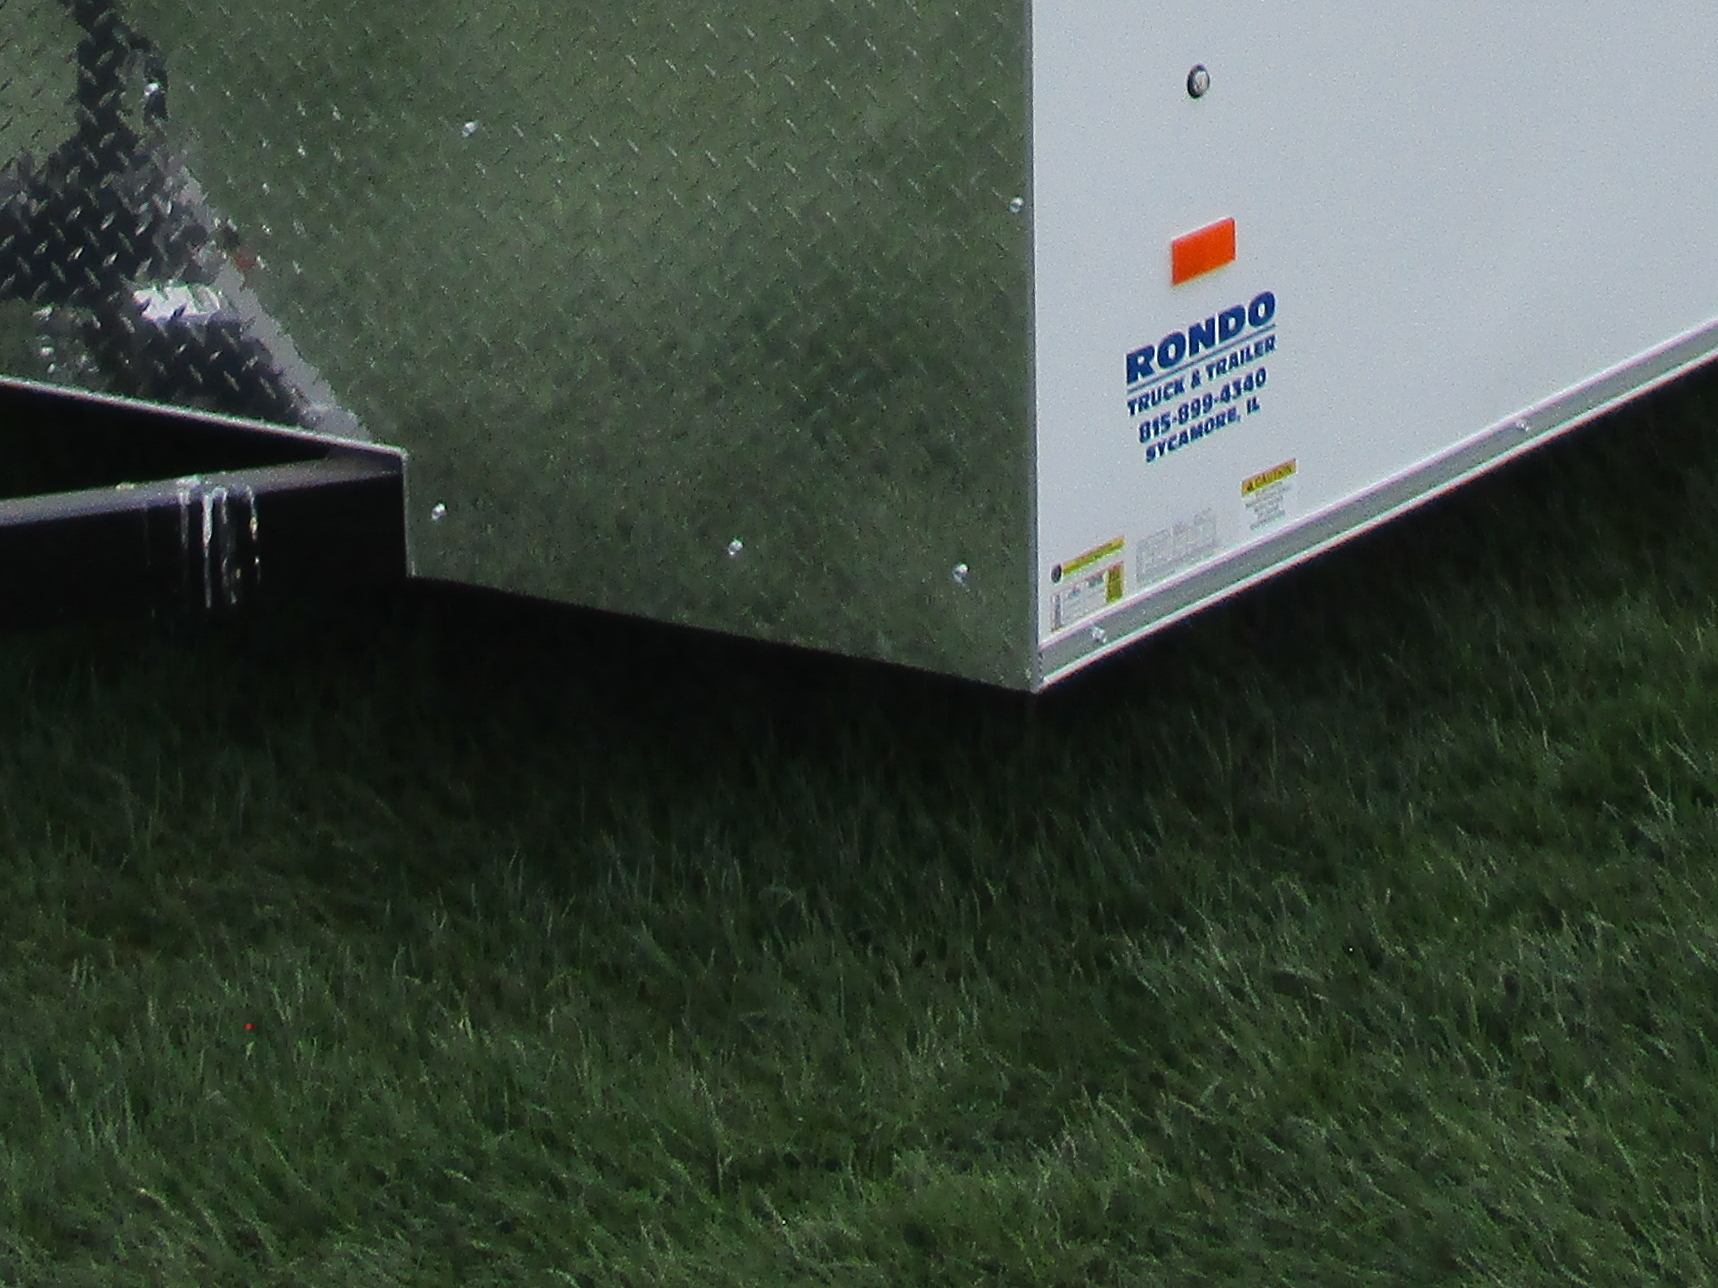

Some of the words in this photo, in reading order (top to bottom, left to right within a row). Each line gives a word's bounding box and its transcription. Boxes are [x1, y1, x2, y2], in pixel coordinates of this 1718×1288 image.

[1126, 291, 1276, 385] RONDO
[1127, 375, 1185, 415] TRUCK
[1190, 368, 1201, 390] &
[1205, 334, 1276, 380] TRAILER
[1246, 395, 1261, 414] IL
